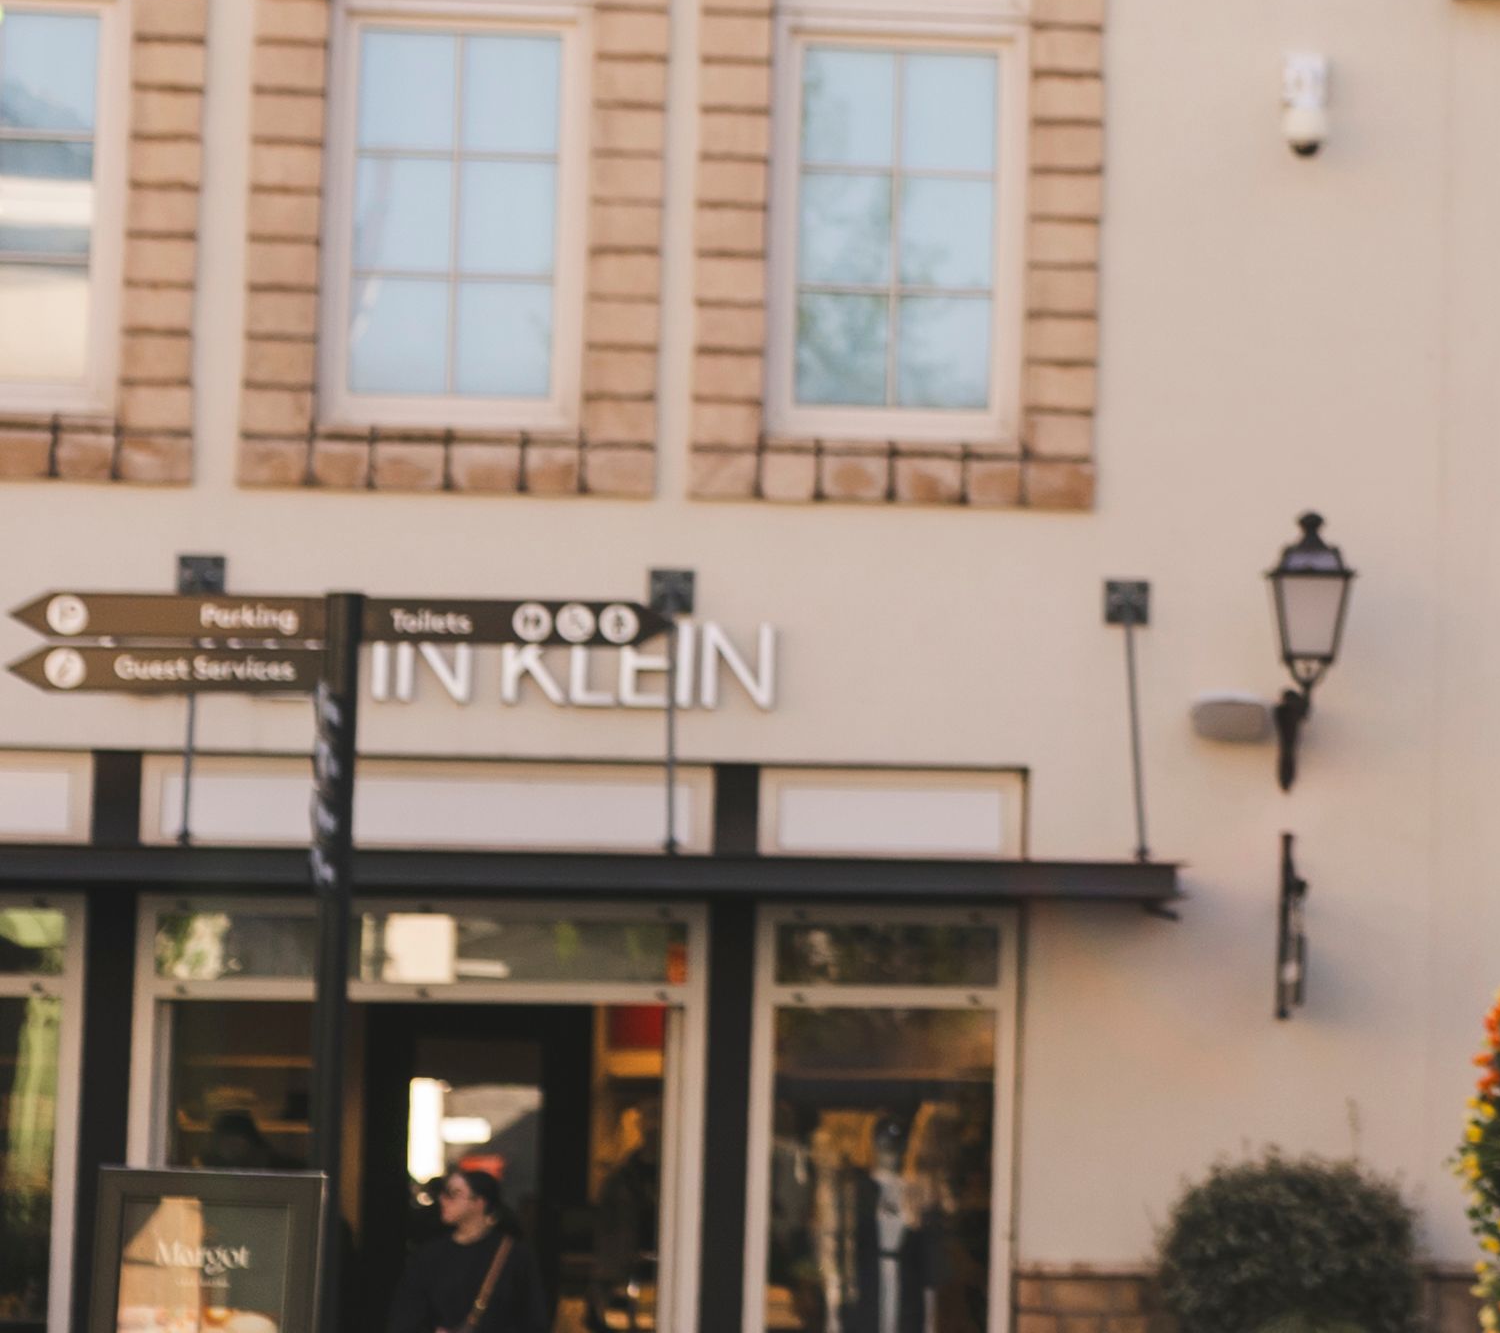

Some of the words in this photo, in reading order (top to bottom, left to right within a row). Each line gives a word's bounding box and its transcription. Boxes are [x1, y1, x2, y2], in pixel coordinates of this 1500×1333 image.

[199, 602, 299, 635] Parking
[389, 608, 473, 634] Toilets
[113, 653, 191, 681] Guest
[192, 653, 297, 682] Services
[501, 617, 778, 712] KLEIN
